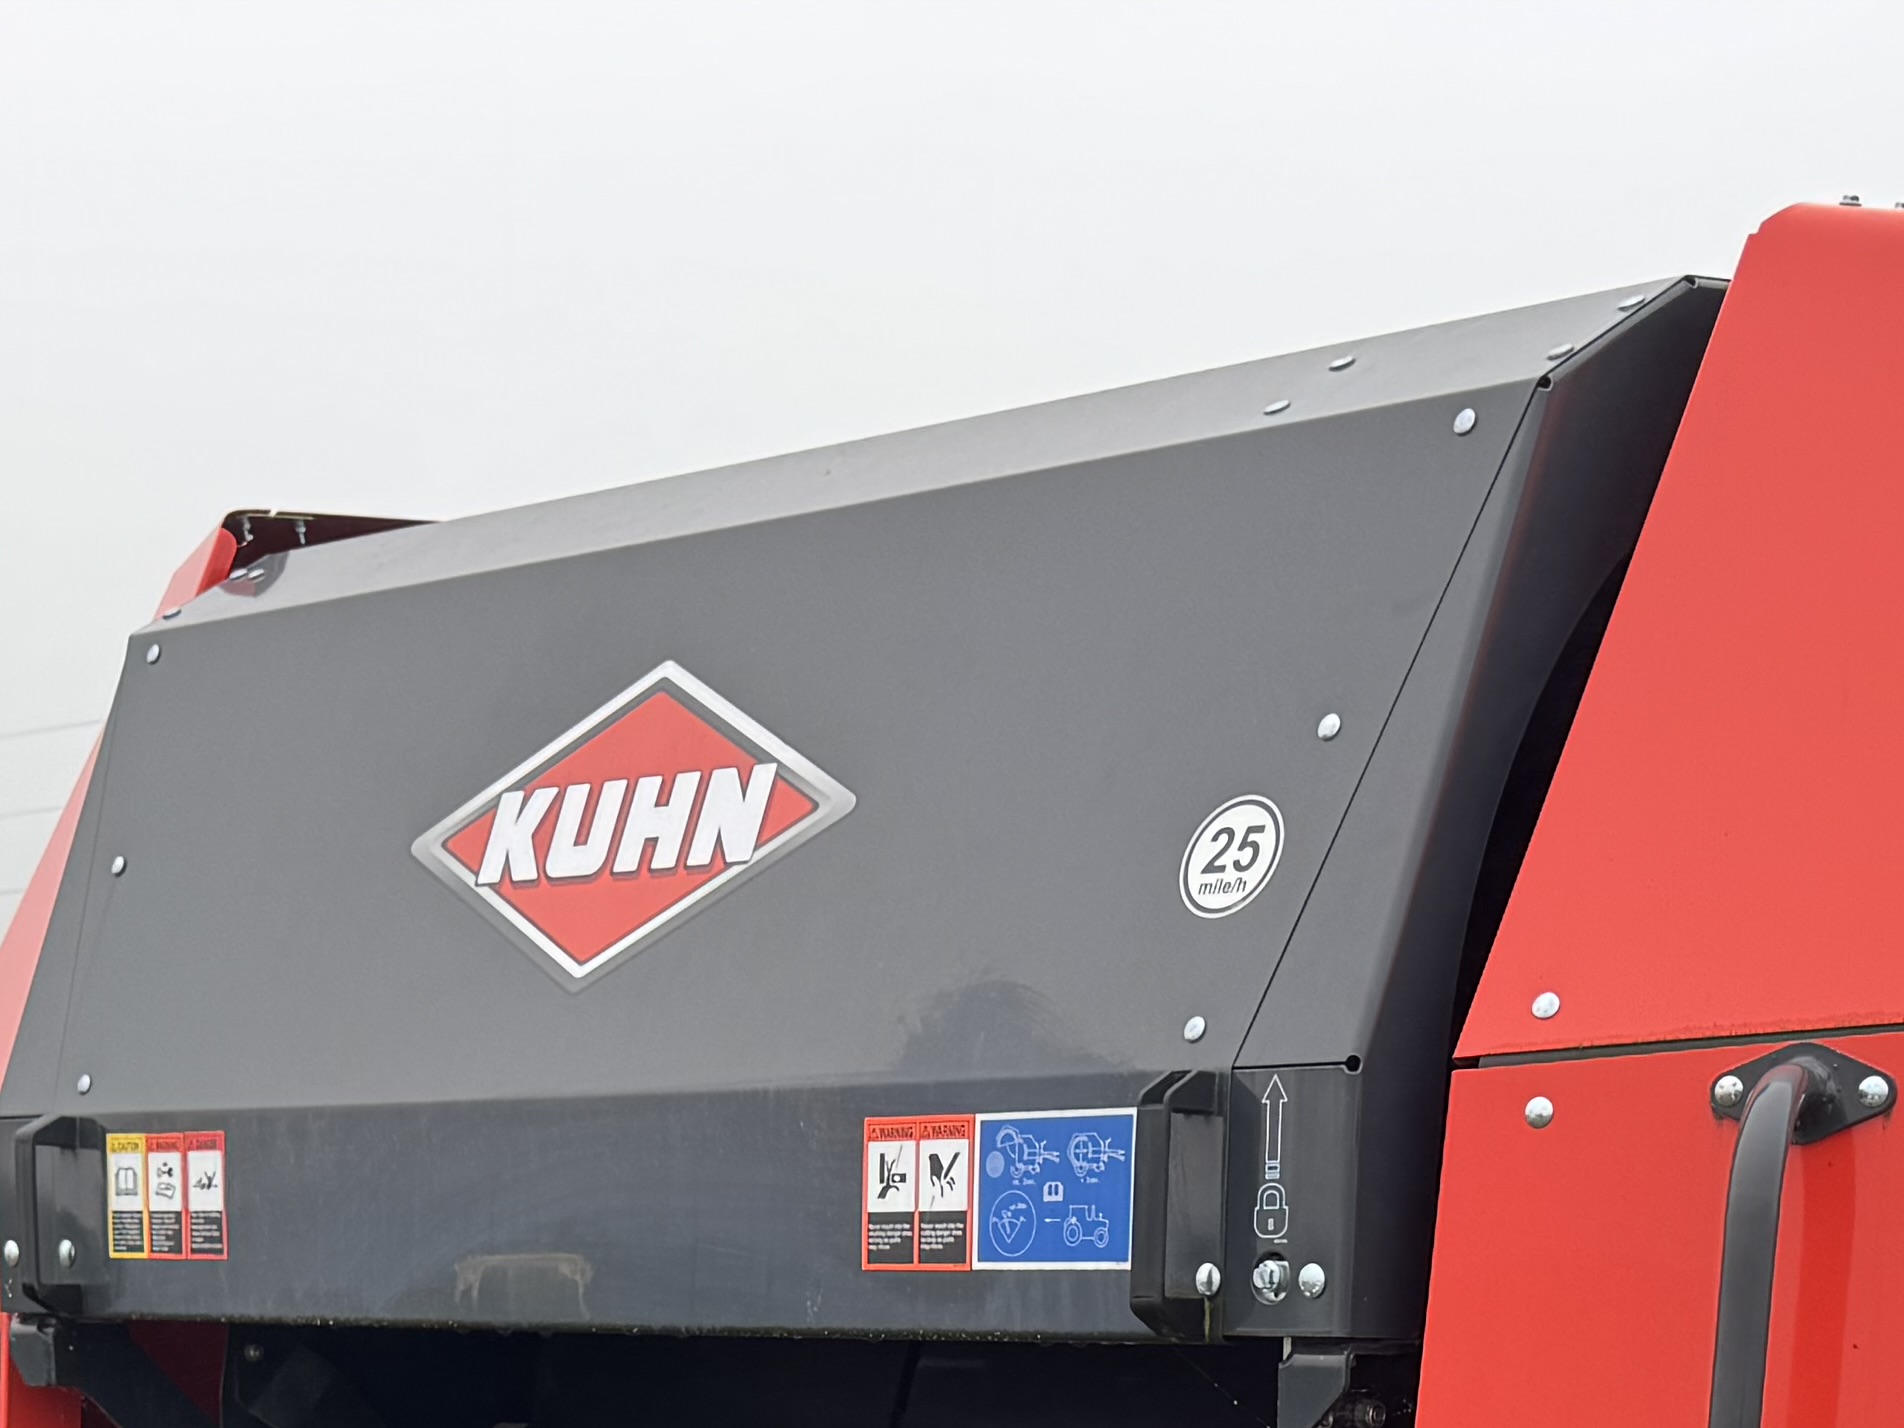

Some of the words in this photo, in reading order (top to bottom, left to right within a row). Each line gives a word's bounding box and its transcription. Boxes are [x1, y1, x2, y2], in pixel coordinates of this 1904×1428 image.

[476, 763, 777, 886] KUHN
[1200, 824, 1266, 874] 25
[1198, 877, 1247, 895] mile/h
[879, 1126, 913, 1139] WARNING
[931, 1124, 966, 1137] WARNING
